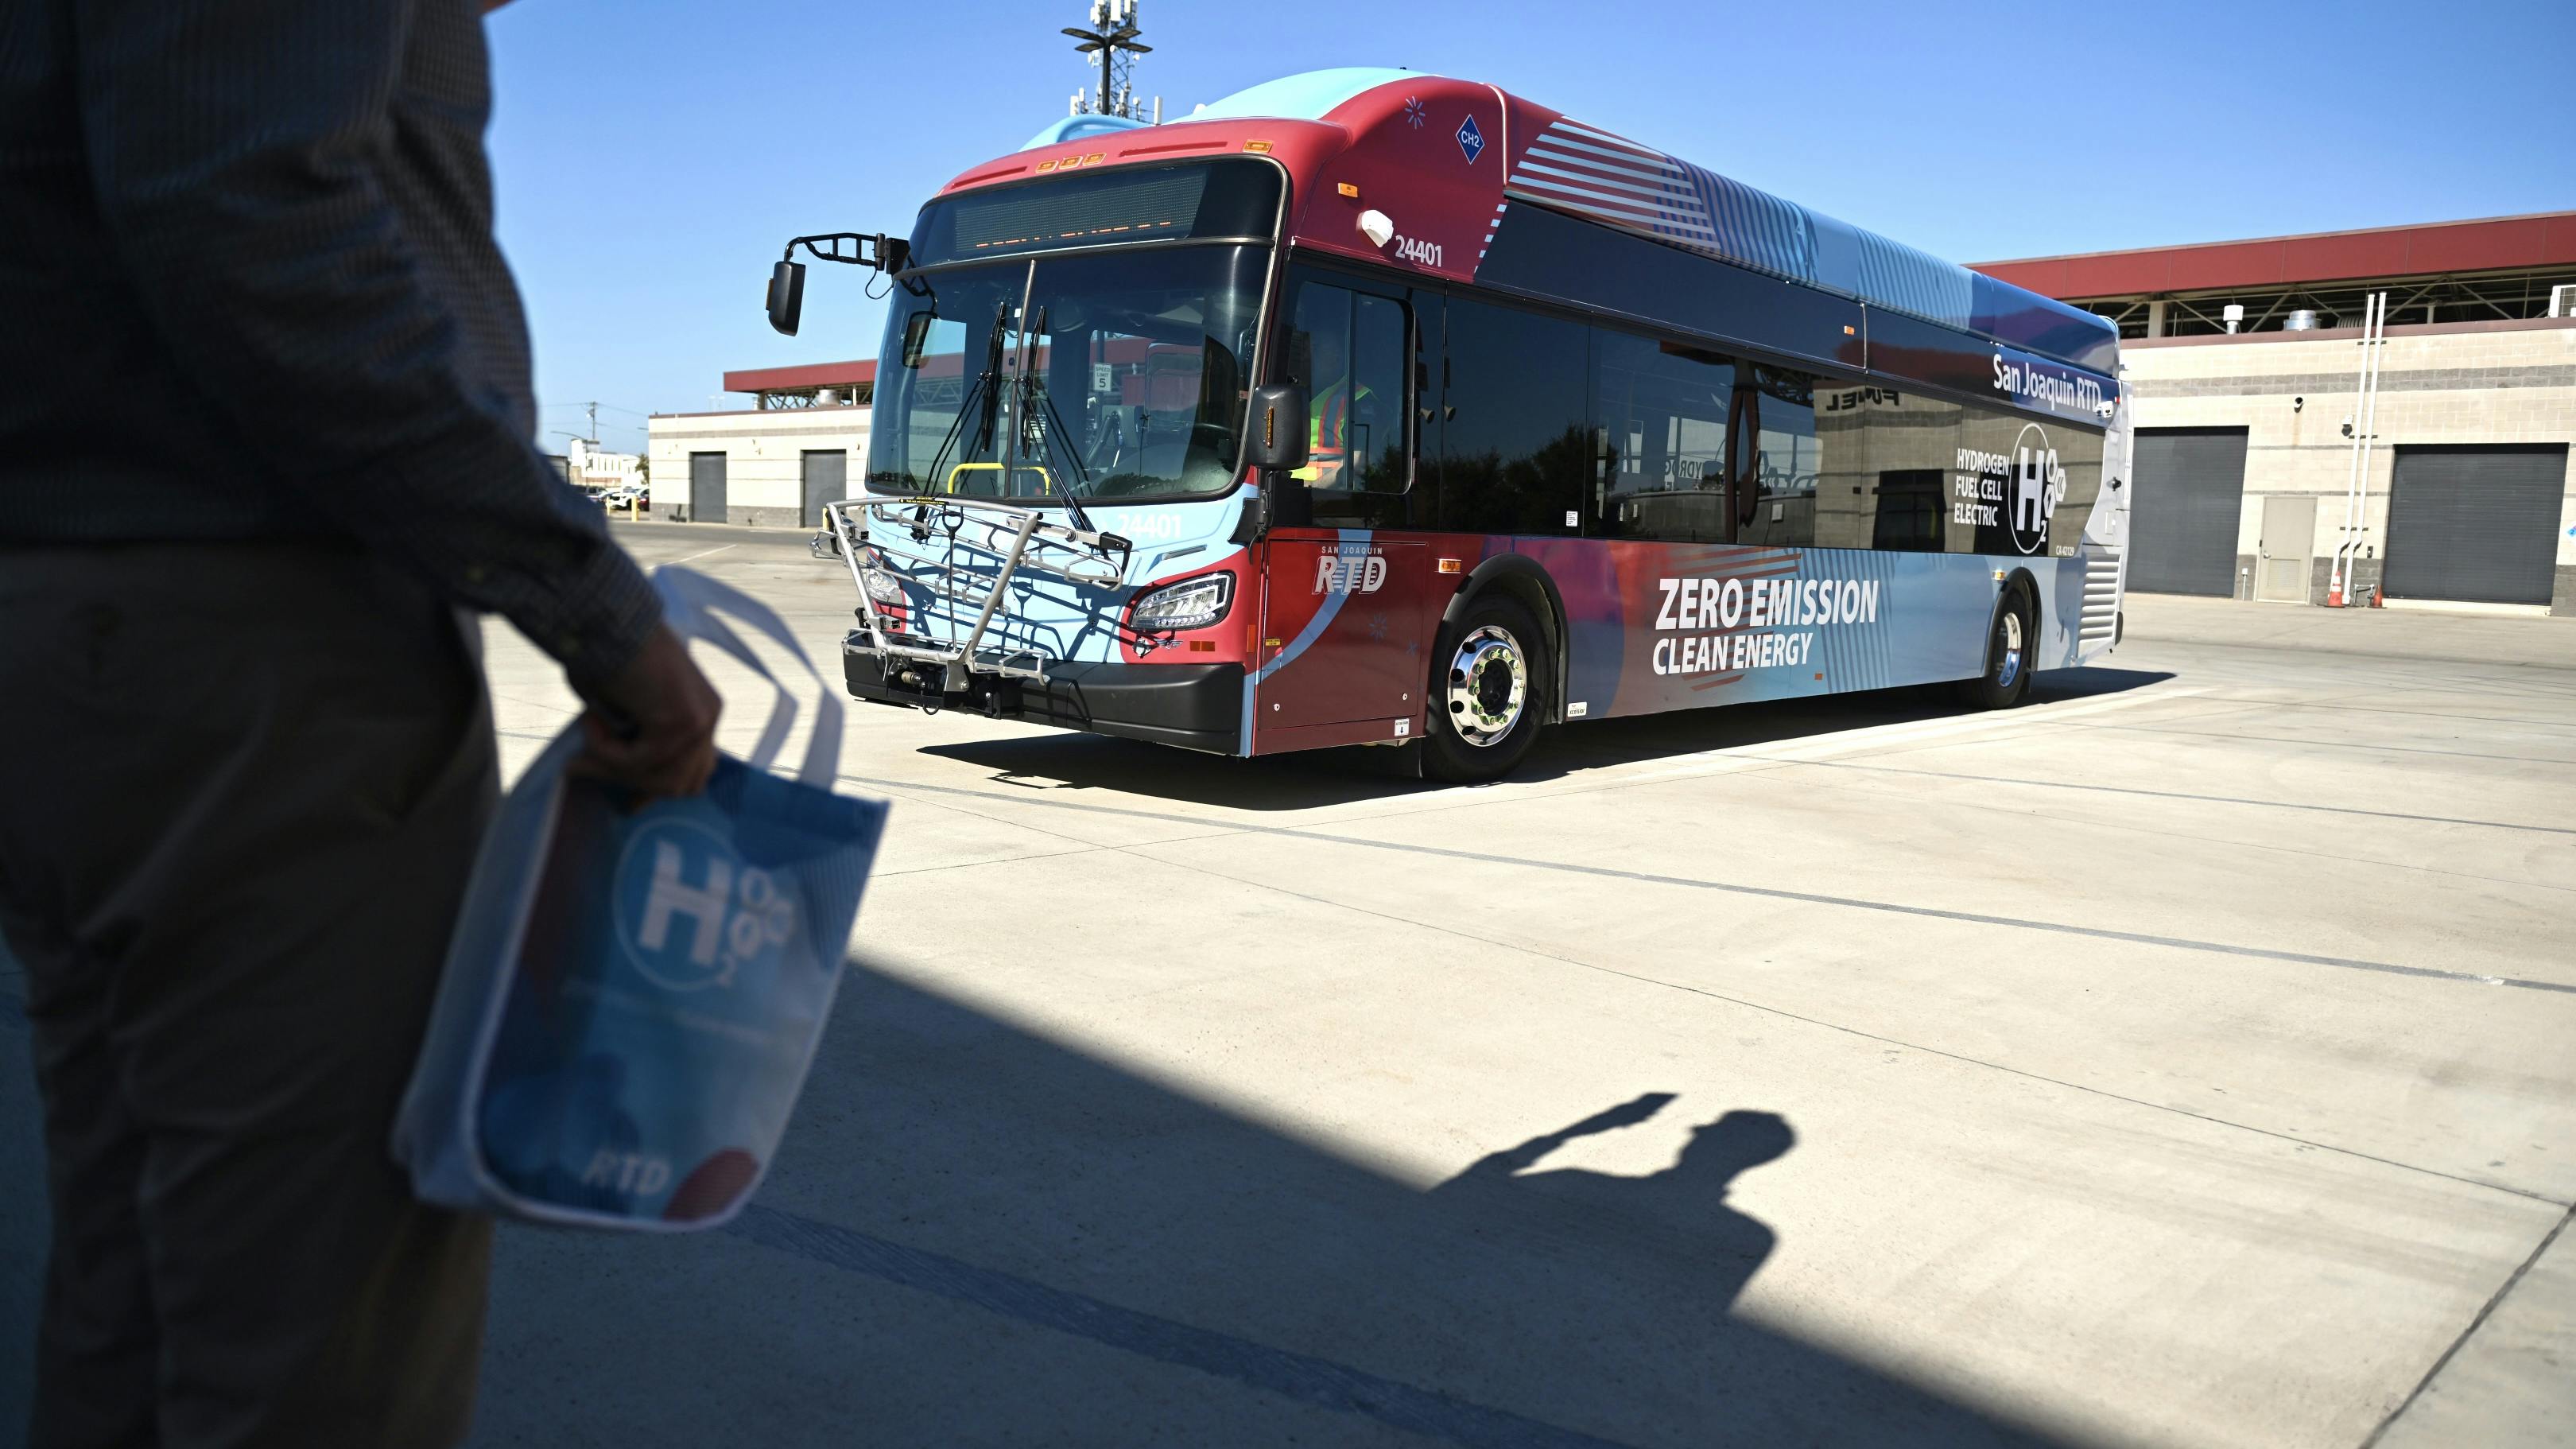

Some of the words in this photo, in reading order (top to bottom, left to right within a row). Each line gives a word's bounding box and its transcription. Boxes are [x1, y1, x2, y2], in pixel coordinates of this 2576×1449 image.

[1461, 130, 1480, 148] CH2
[1395, 235, 1442, 267] 24401
[1099, 378, 1106, 388] 5
[1993, 353, 2021, 394] San
[2023, 363, 2074, 411] Joaquin
[2077, 377, 2101, 412] RTD
[1957, 448, 2010, 476] HYDROGEN
[1955, 476, 1980, 499] FUEL
[1980, 478, 2003, 501] CELL
[1117, 514, 1182, 538] 24401
[1953, 503, 1998, 527] ELECTRIC
[2056, 546, 2062, 556] CA
[1312, 555, 1387, 595] RTD
[1655, 578, 1744, 630] ZERO
[1749, 579, 1879, 627] EMISSION
[1652, 635, 1728, 675] CLEAN
[1732, 632, 1814, 670] ENERGY
[582, 1150, 673, 1195] RTD
